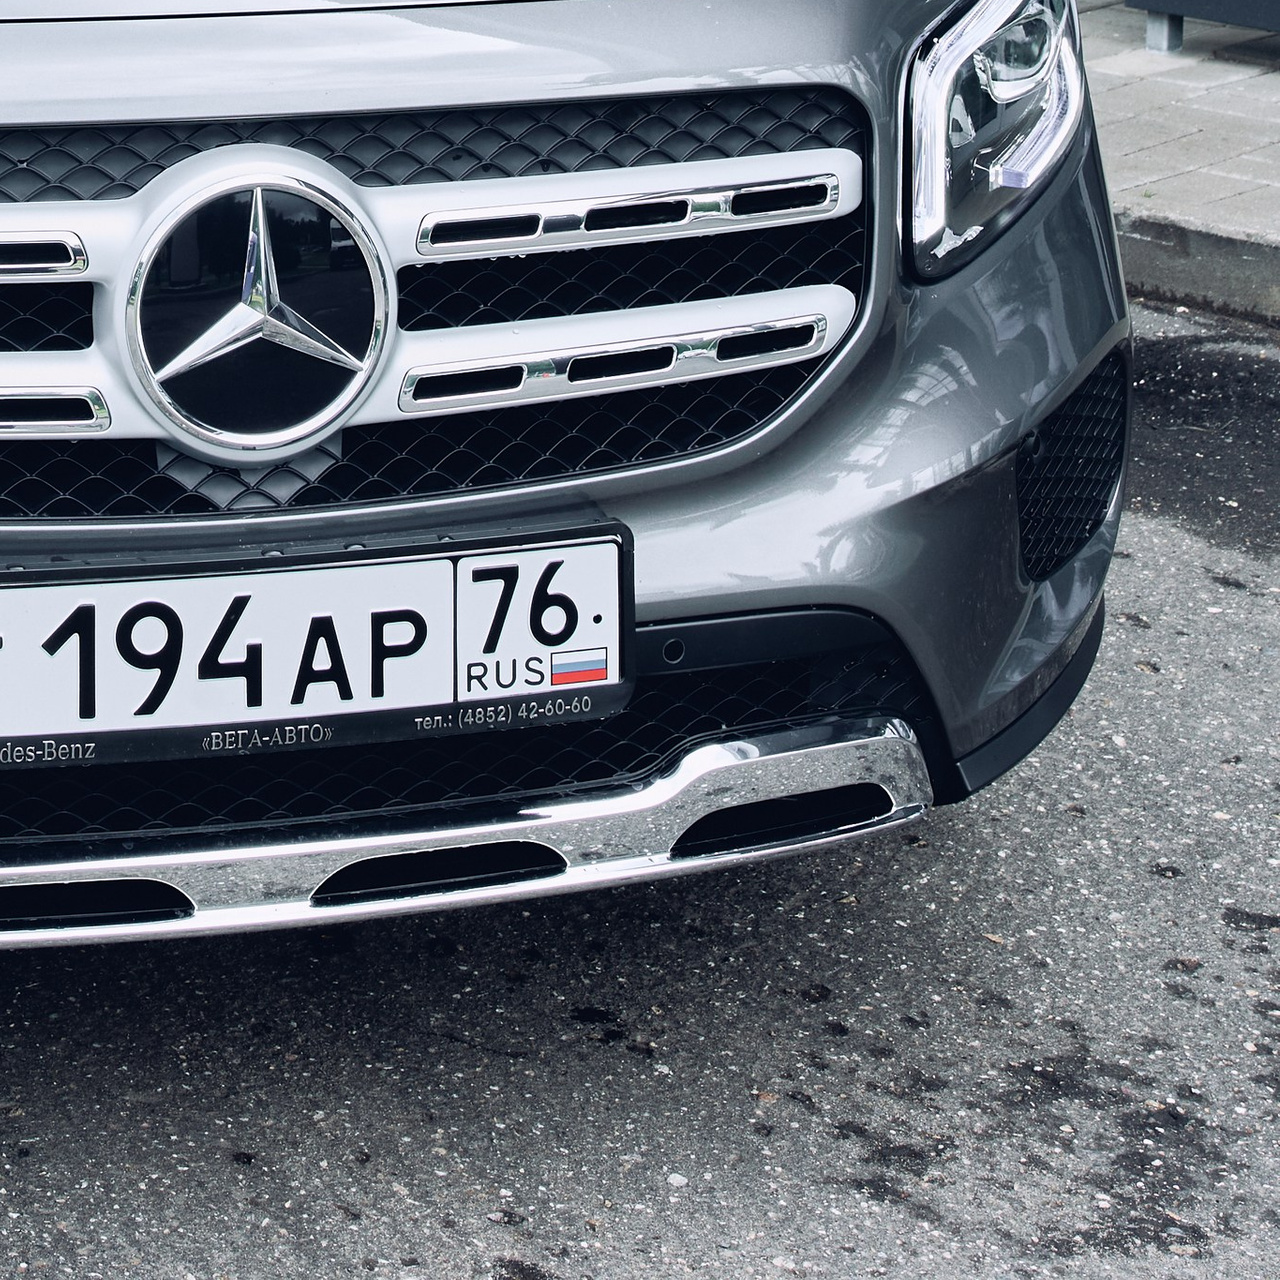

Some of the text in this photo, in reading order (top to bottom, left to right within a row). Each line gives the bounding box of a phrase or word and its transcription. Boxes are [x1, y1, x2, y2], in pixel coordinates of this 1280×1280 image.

[470, 559, 580, 654] 76
[466, 657, 547, 693] RUS
[457, 703, 513, 729] (4852)
[517, 695, 593, 721] 42-60-60
